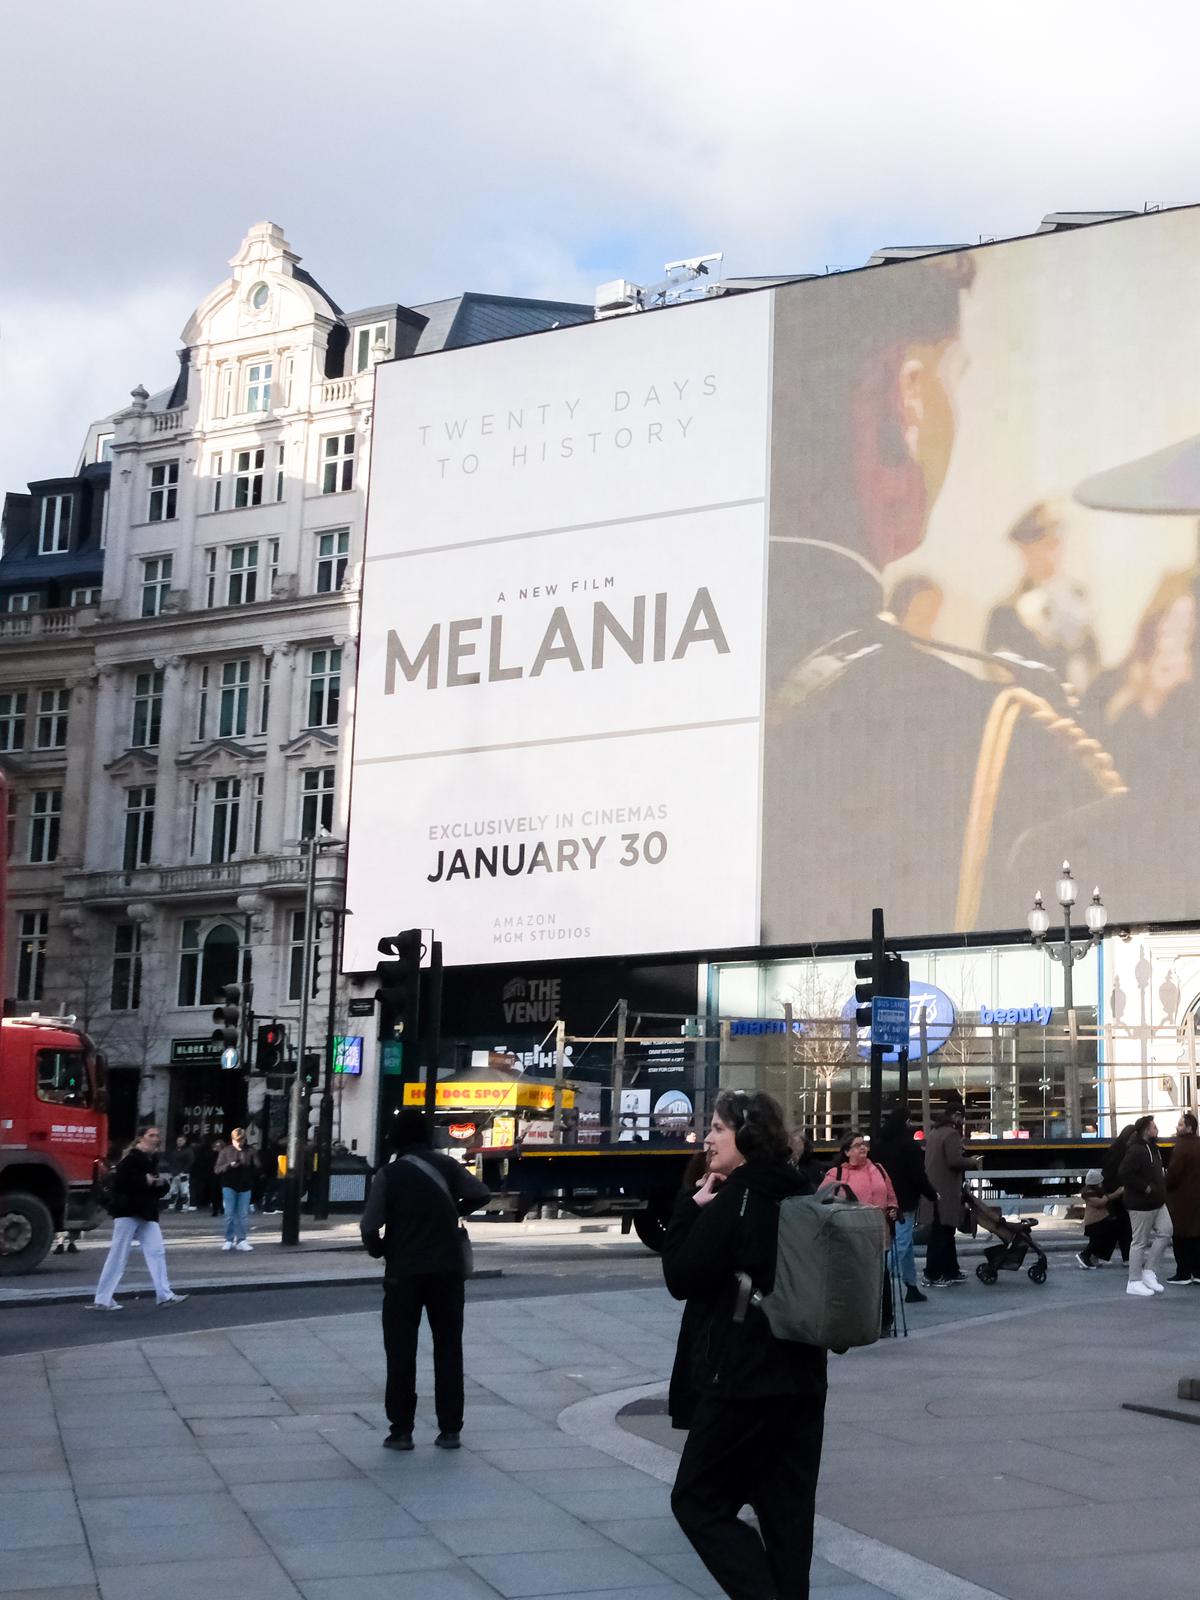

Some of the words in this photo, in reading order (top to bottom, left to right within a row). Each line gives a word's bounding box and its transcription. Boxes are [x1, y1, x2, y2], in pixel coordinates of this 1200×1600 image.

[418, 398, 581, 446] TWENTY
[614, 374, 718, 412] DAYS
[437, 453, 480, 479] TO
[511, 416, 694, 467] HISTORY
[497, 591, 506, 603] A
[519, 583, 558, 600] NEW
[571, 576, 615, 593] FILM
[384, 586, 731, 696] MELANIA
[429, 815, 549, 841] EXCLUSIVELY
[555, 812, 574, 829] IN
[581, 803, 668, 827] CINEMAS
[427, 836, 606, 883] JANUARY
[619, 830, 668, 868] 30
[493, 913, 556, 930] AMAZON
[493, 931, 522, 945] MGM
[530, 926, 592, 942] STUDIOS
[528, 979, 561, 1000] THE
[503, 1000, 561, 1023] VENUE
[980, 1003, 1053, 1026] beauty
[442, 1089, 471, 1099] DOG
[474, 1088, 509, 1099] SPOT
[183, 1123, 224, 1135] OPEN
